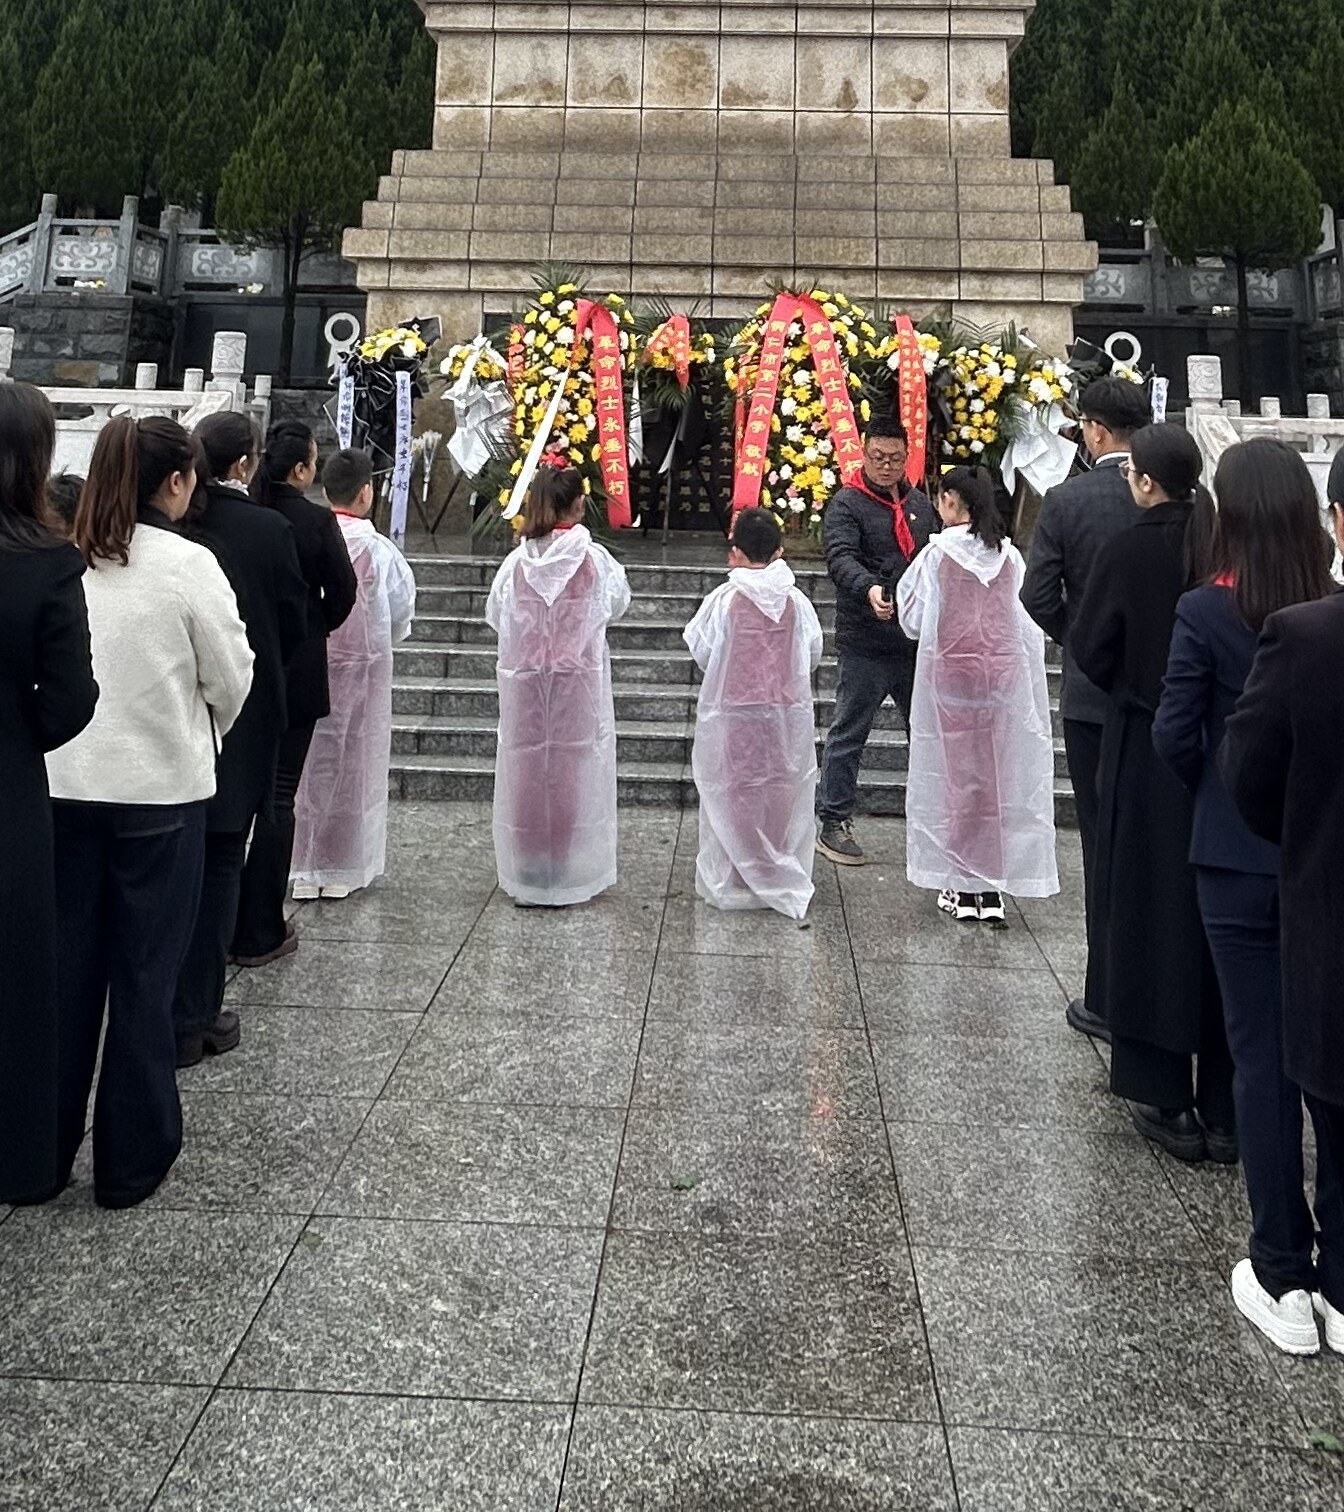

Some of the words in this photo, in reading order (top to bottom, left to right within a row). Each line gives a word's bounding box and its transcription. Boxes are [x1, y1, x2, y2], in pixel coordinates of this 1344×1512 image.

[597, 335, 625, 496] 革命烈士永垂不朽
